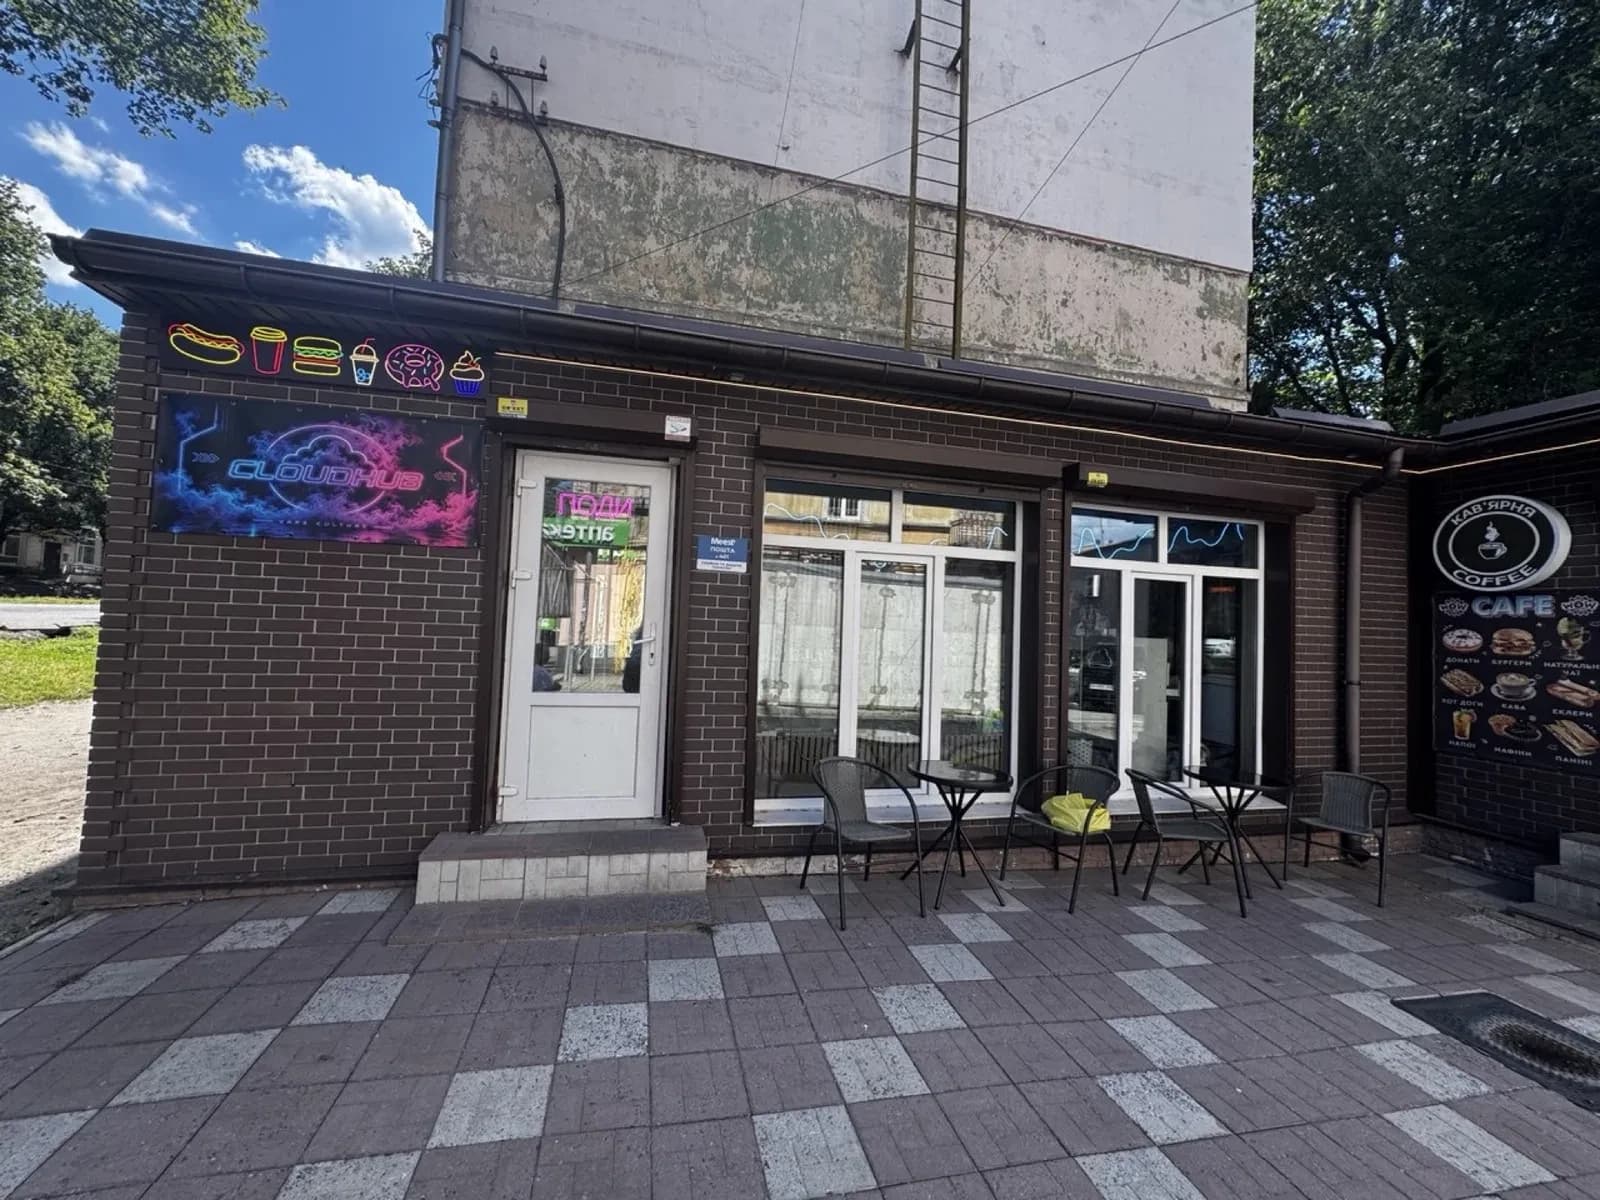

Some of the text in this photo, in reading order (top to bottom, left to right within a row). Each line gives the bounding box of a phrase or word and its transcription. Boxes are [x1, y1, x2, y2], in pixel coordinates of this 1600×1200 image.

[227, 458, 424, 491] CLOUDHUB
[555, 492, 634, 520] ПОДИ
[1450, 499, 1536, 526] КАВ'ЯРНЯ
[1452, 564, 1537, 587] COFFEE
[1470, 594, 1556, 618] CAFE
